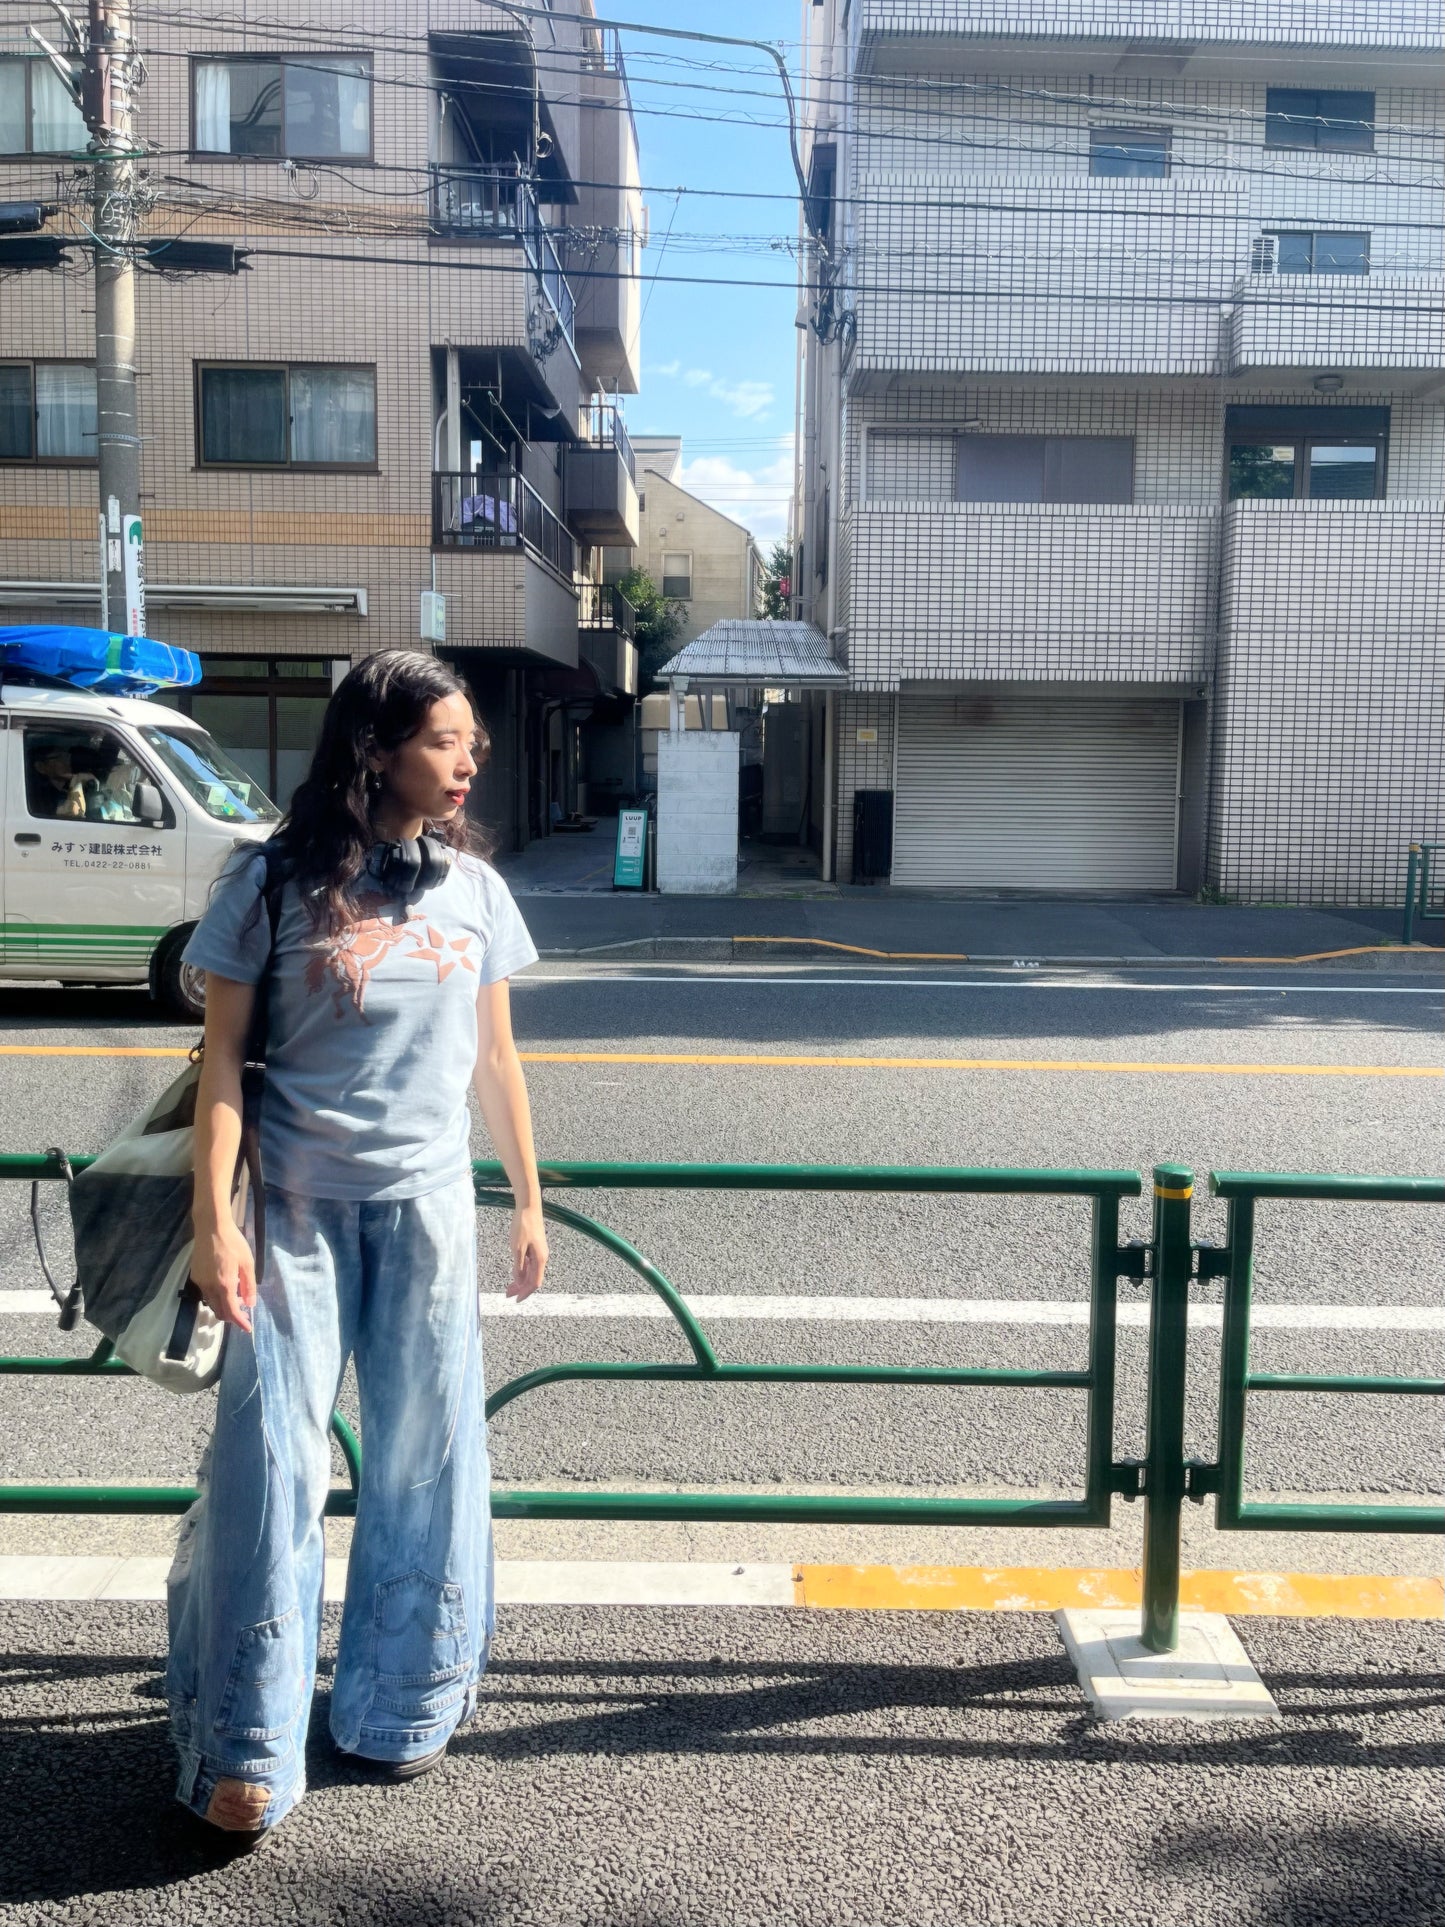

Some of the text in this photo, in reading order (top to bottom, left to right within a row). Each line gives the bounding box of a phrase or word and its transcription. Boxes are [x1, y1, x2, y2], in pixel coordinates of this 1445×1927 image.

[51, 841, 162, 857] みすゞ建設株式会社
